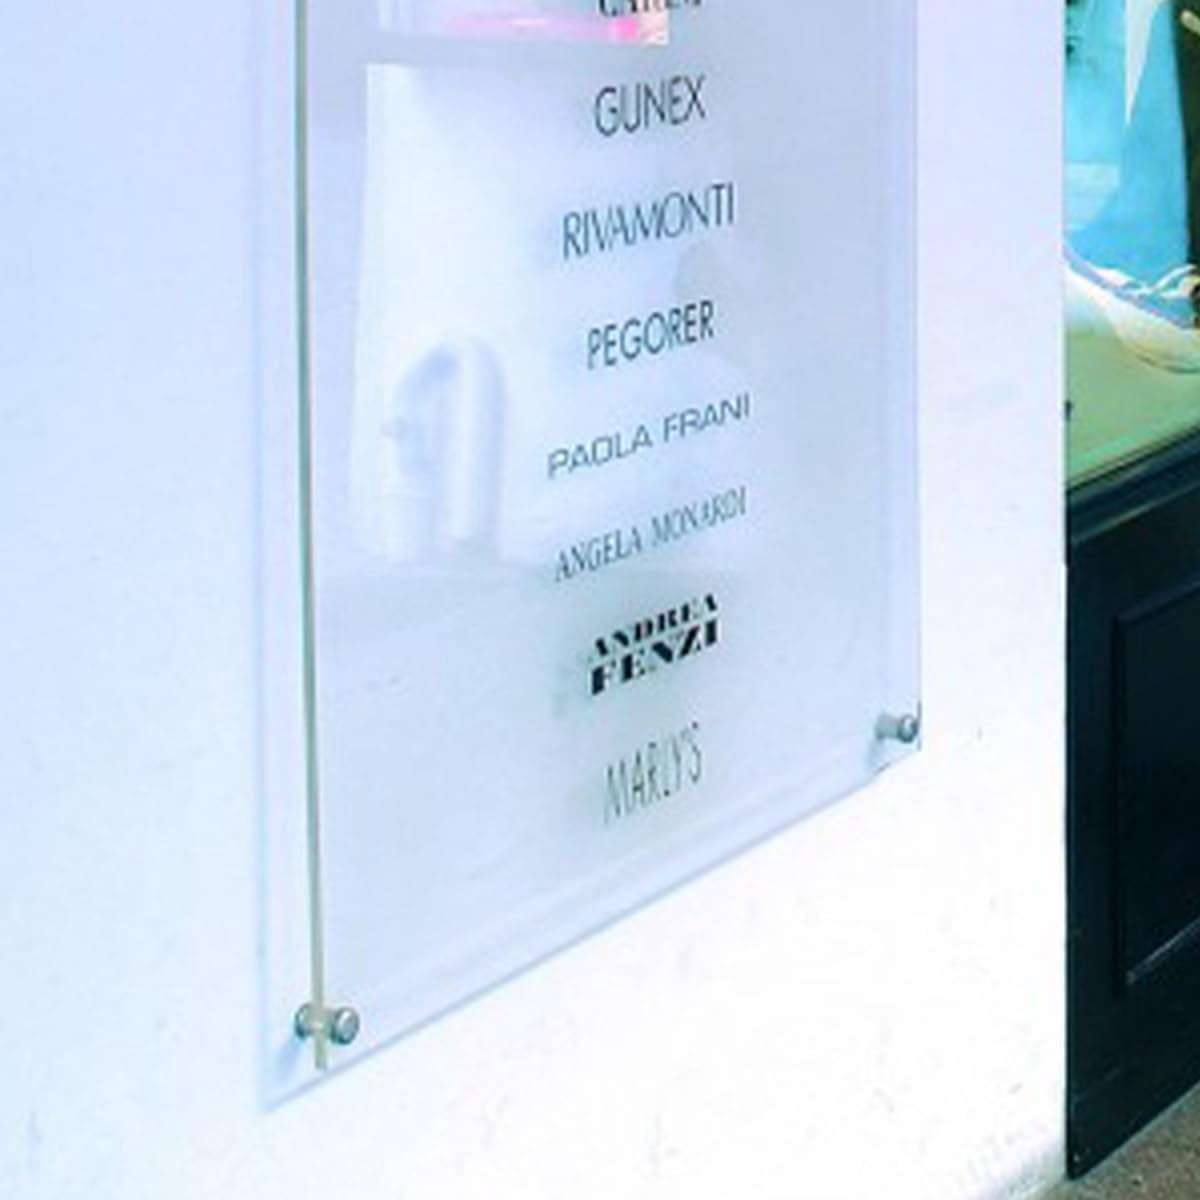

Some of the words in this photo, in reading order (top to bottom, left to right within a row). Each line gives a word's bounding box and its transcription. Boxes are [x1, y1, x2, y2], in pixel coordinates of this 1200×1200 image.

[594, 75, 706, 136] GUNEX
[562, 181, 734, 261] RIVAMONTI
[587, 300, 715, 370] PEGORER
[548, 424, 654, 479] PAOLA
[663, 391, 750, 443] FRANI
[555, 526, 643, 583] ANGELA
[587, 593, 718, 658] ANDREA
[590, 618, 718, 697] FENZI
